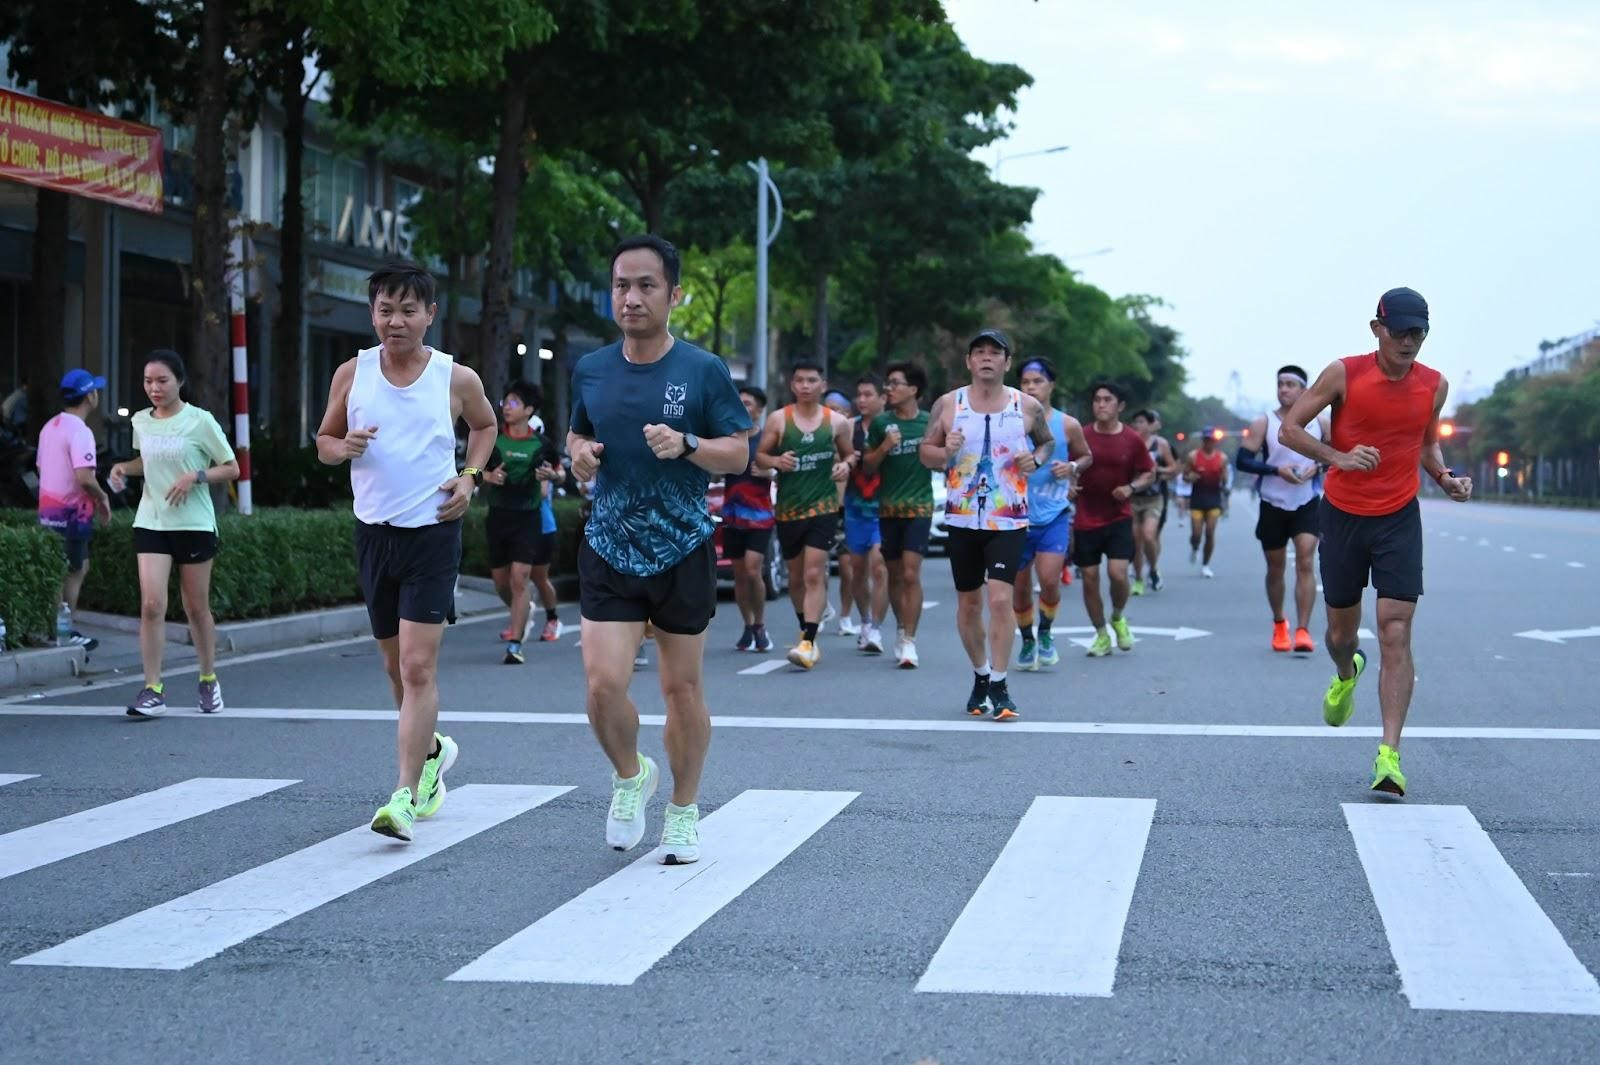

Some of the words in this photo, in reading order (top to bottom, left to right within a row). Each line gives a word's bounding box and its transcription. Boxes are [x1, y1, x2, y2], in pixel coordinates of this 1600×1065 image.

[15, 100, 49, 134] TRÁCH
[62, 152, 81, 179] GIA
[663, 403, 685, 416] OTSO
